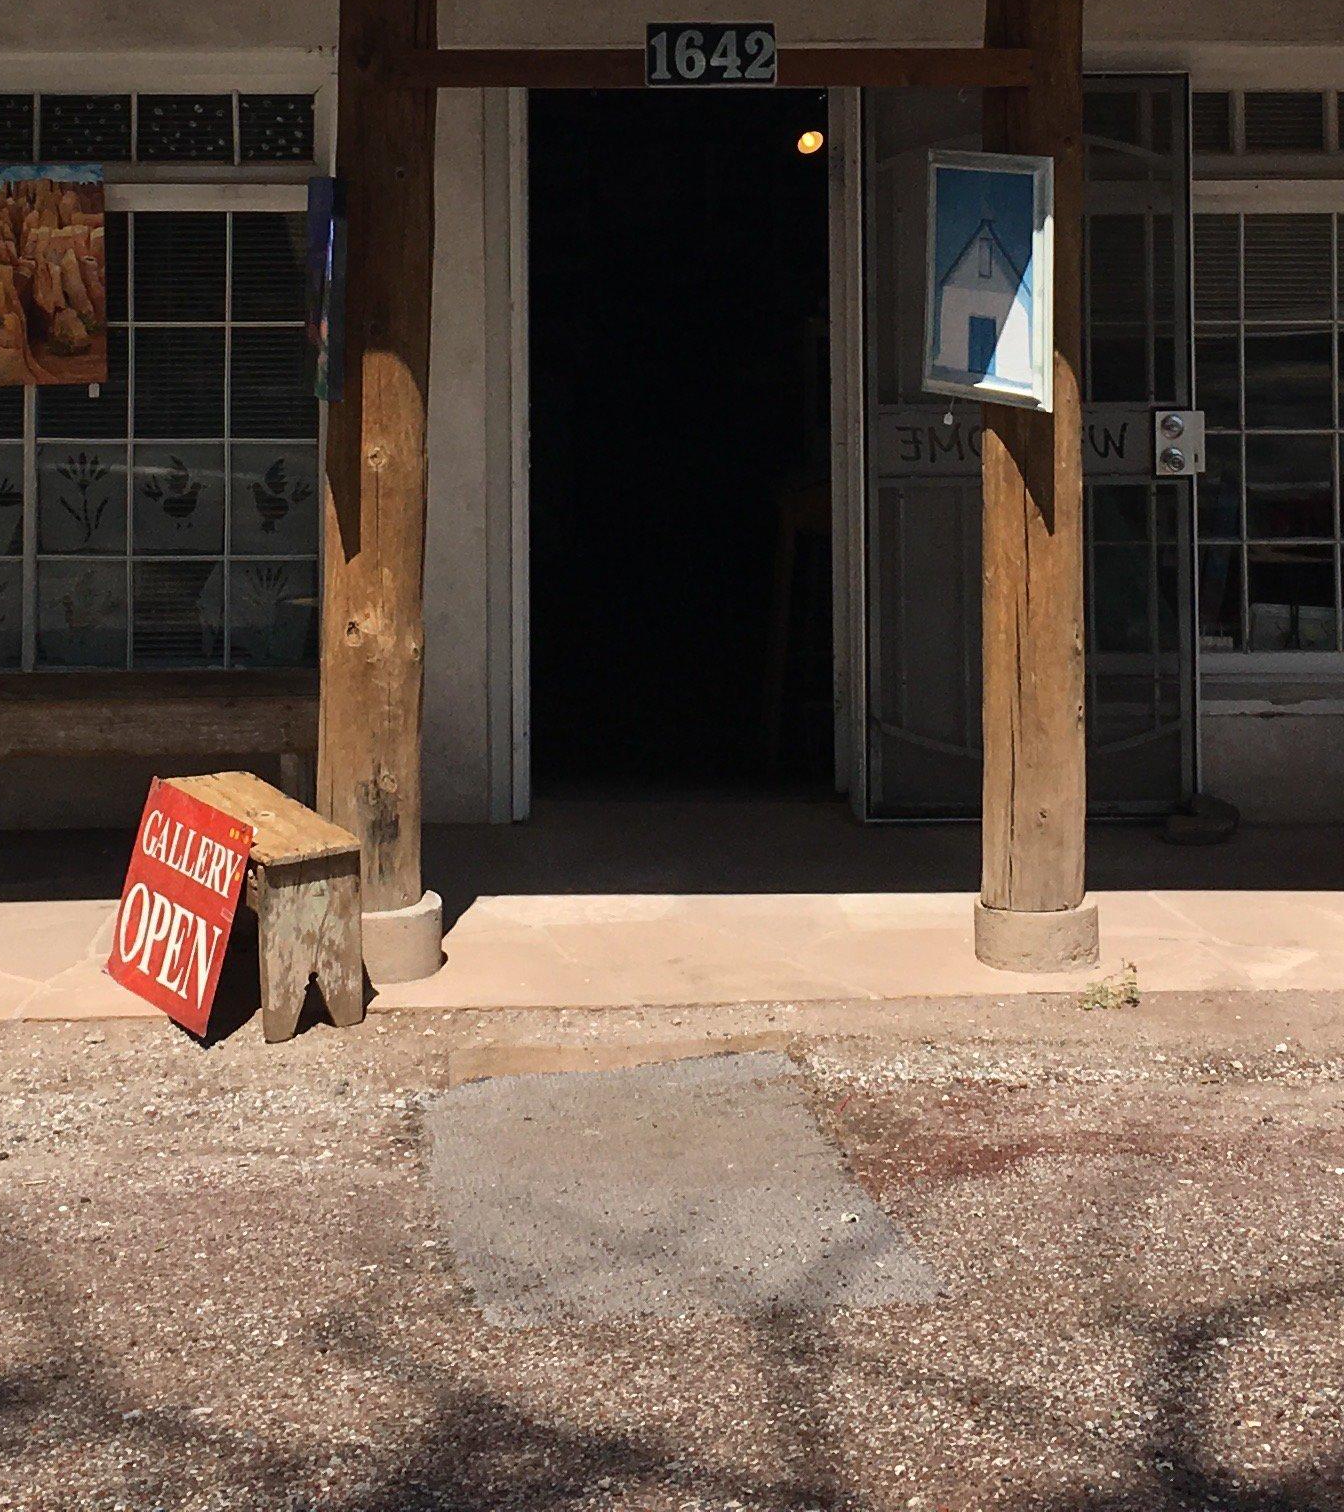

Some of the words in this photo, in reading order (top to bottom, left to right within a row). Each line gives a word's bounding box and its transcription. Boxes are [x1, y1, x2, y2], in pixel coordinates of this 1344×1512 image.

[650, 29, 776, 80] 1642
[142, 809, 243, 899] GALLERY
[119, 882, 223, 1010] OPEN
